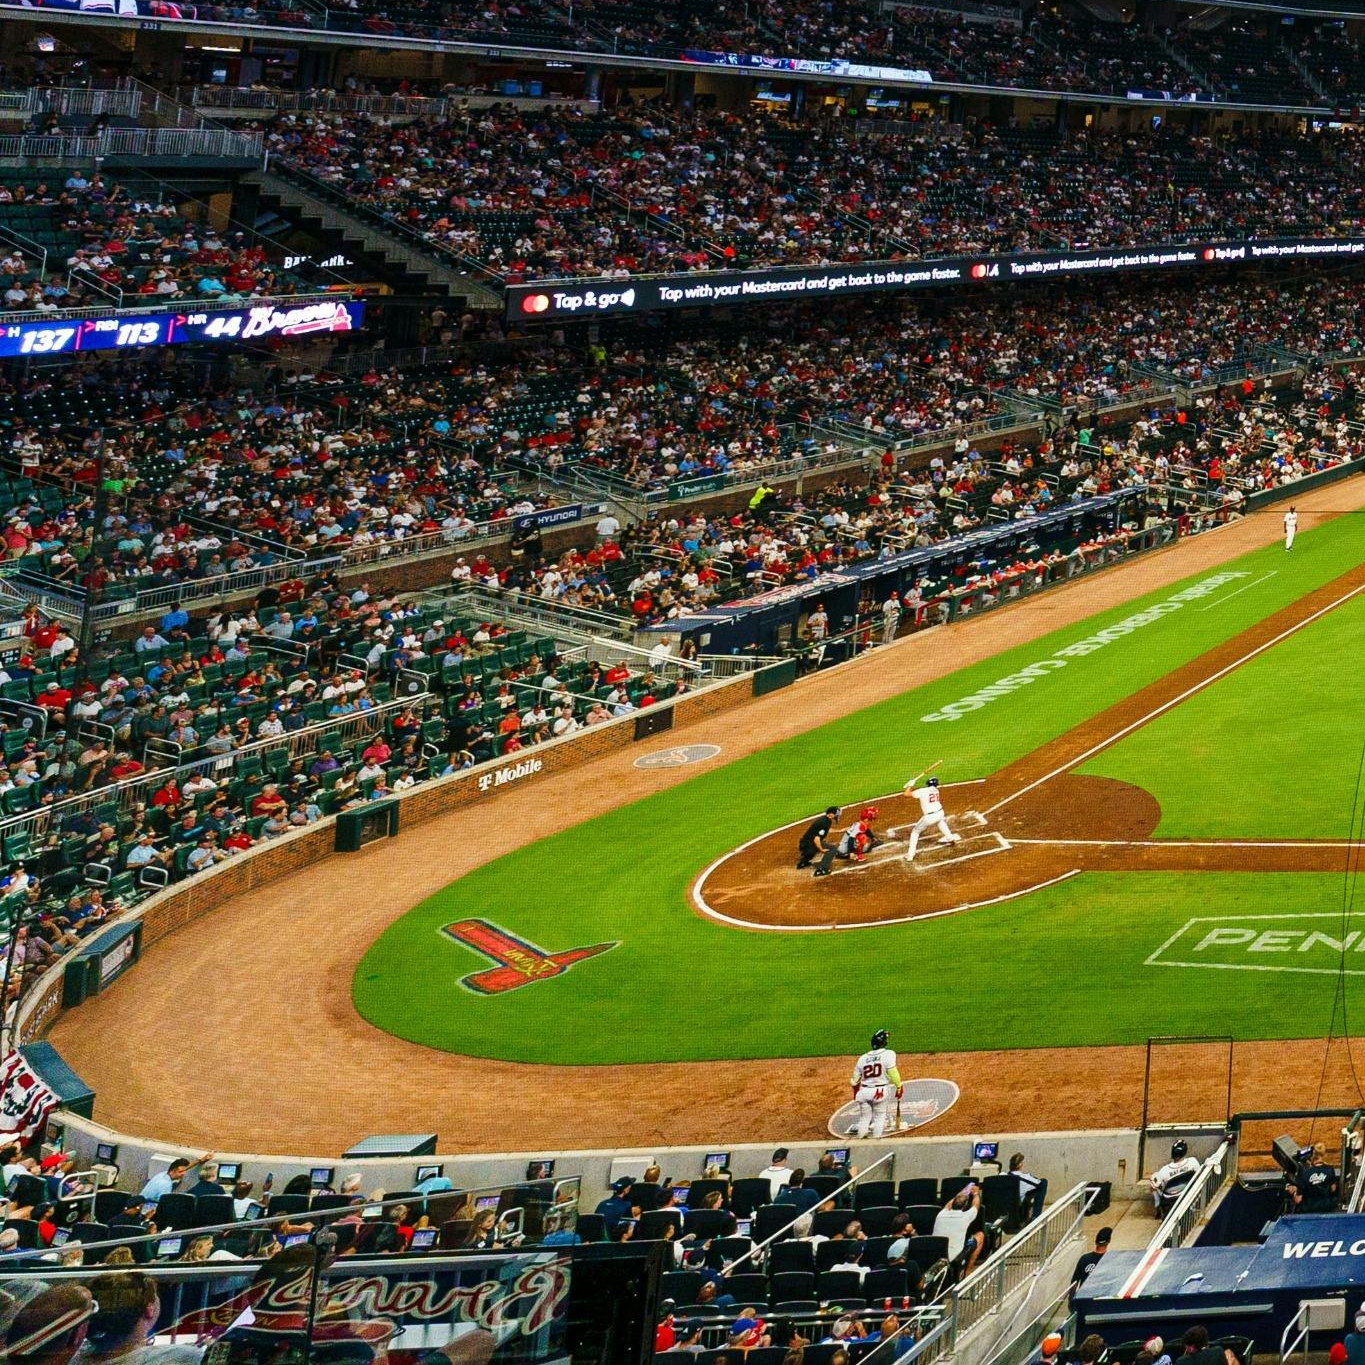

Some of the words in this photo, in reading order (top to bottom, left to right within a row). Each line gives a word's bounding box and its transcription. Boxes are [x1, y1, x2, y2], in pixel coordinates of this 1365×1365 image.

[659, 287, 683, 302] Tap
[685, 285, 712, 298] with
[713, 283, 742, 299] your
[743, 277, 806, 294] Mastercard
[807, 277, 827, 290] and
[829, 276, 847, 290] get
[849, 272, 872, 287] back
[873, 273, 885, 285] to
[886, 271, 903, 283] the
[904, 271, 932, 285] game
[933, 268, 961, 282] faster.
[553, 292, 583, 310] Tap
[584, 293, 598, 306] &
[95, 320, 120, 332] RBI
[116, 322, 161, 345] 113
[188, 314, 207, 326] HR
[205, 317, 243, 337] 44
[8, 326, 21, 338] H
[20, 329, 75, 353] 137
[537, 509, 578, 525] HYUNDAI
[919, 658, 1069, 724] CASINOS
[494, 758, 542, 787] Mobile
[863, 1063, 882, 1079] 20
